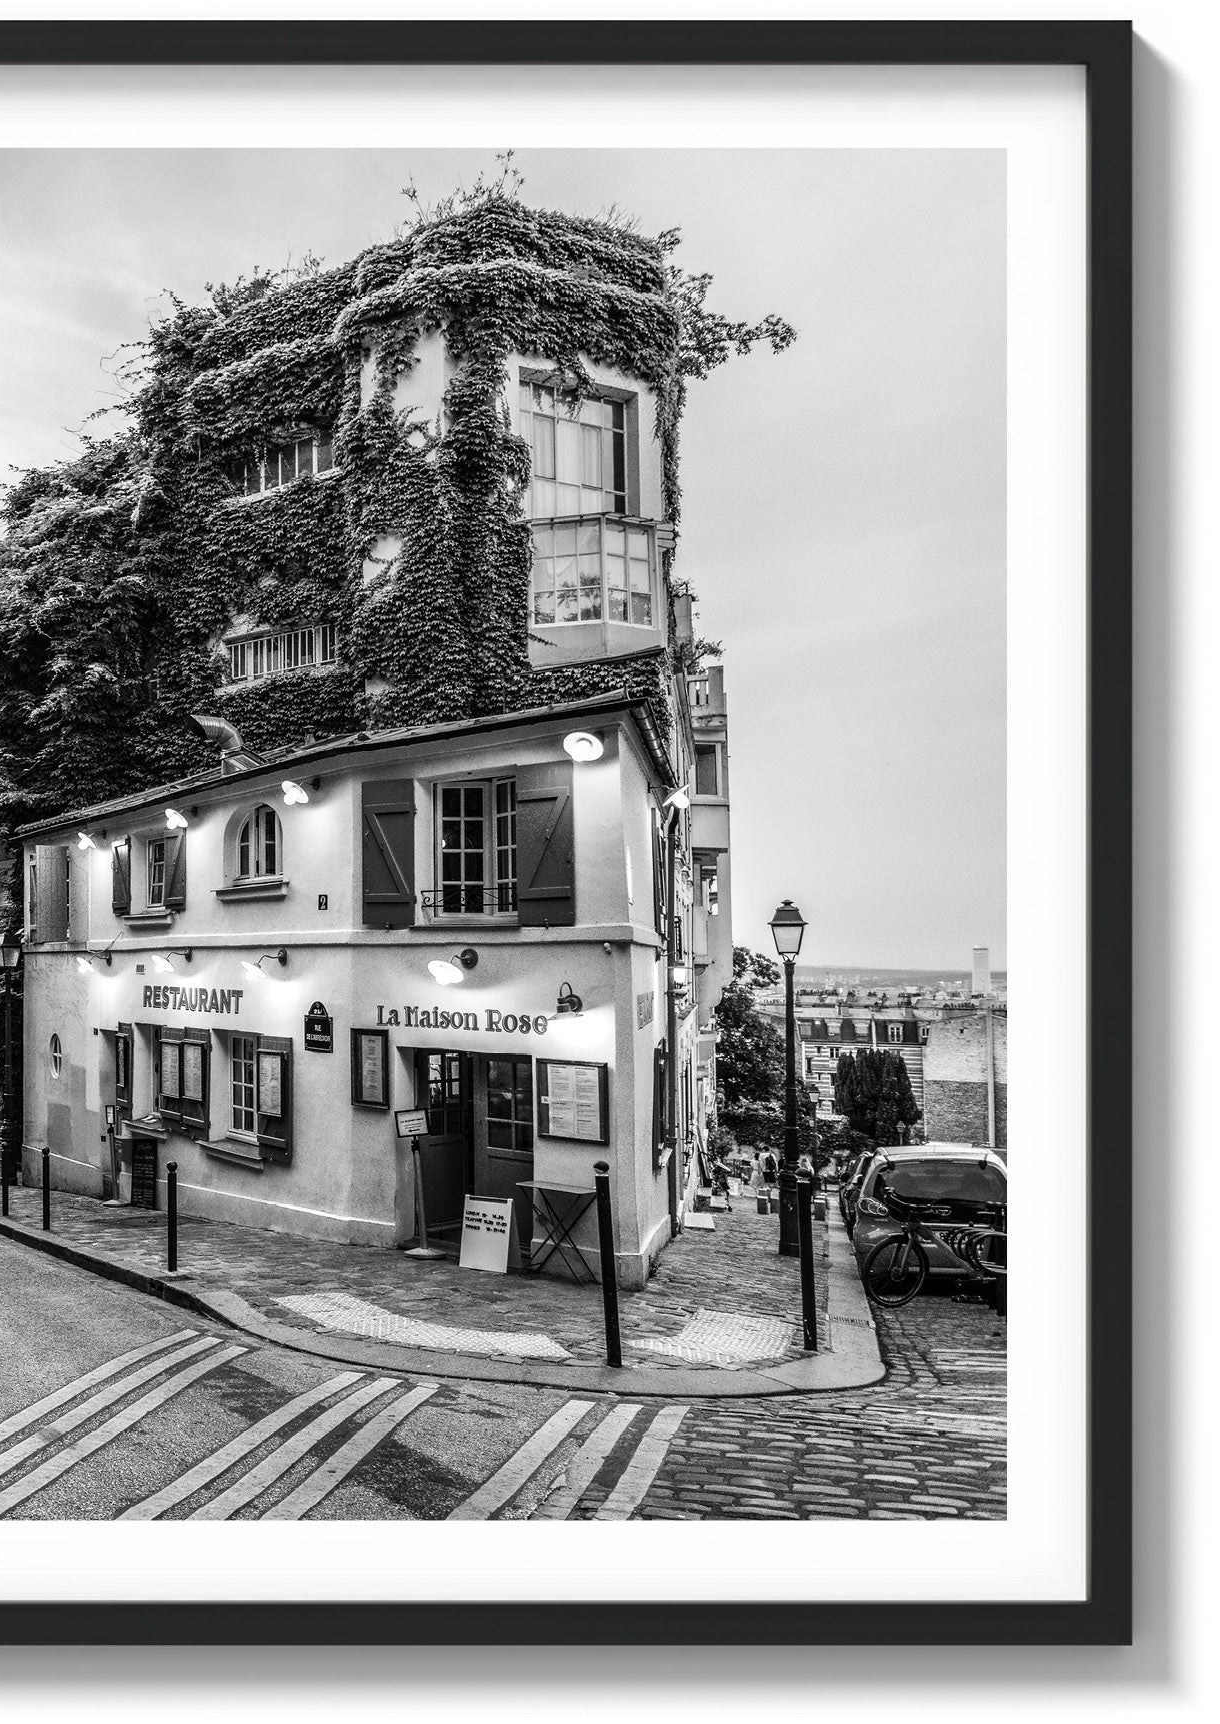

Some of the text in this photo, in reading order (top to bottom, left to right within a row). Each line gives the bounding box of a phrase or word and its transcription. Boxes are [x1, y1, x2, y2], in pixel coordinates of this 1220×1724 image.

[143, 985, 244, 1014] RESTAURANT
[376, 1005, 548, 1035] La Maison Rose
